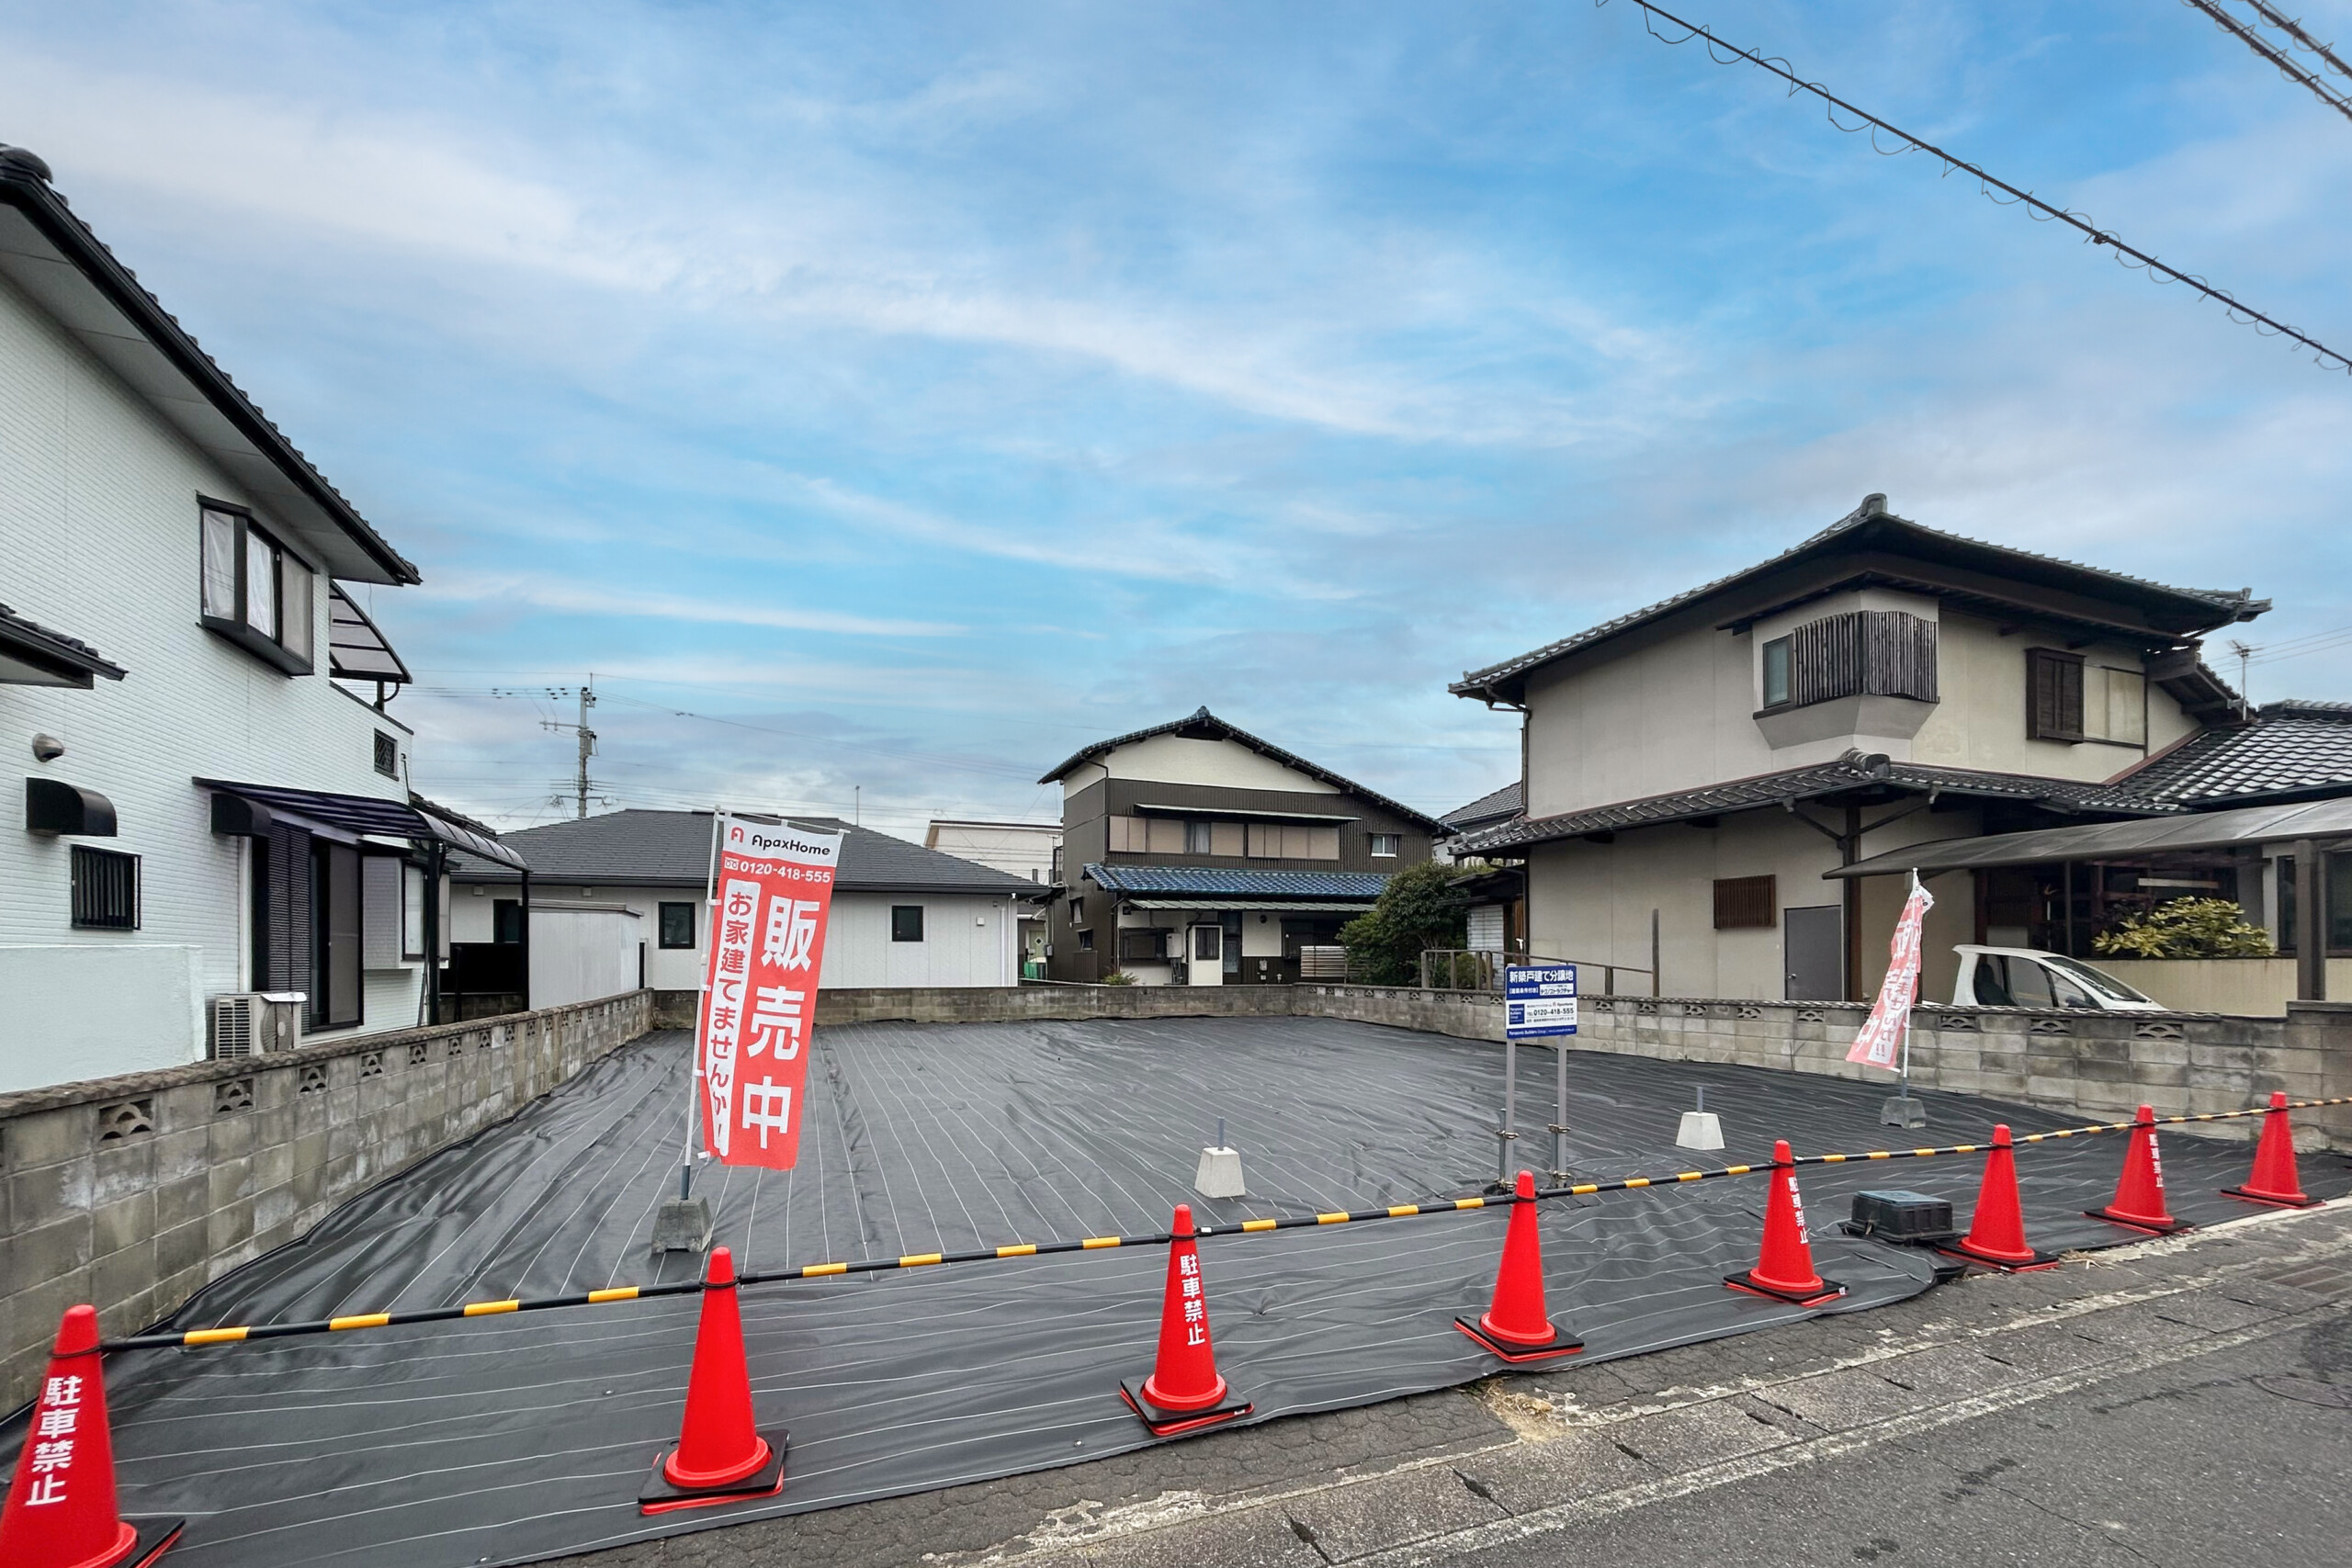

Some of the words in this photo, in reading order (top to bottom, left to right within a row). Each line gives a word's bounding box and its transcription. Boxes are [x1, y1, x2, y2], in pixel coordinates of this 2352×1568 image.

[740, 861, 831, 884] 0120-418-555
[752, 834, 831, 856] ApaxHome
[741, 895, 820, 1149] 販売中
[1533, 1008, 1575, 1017] 0120-418-555
[1179, 1253, 1206, 1347] 駐車禁止
[25, 1374, 84, 1507] 駐車禁止
